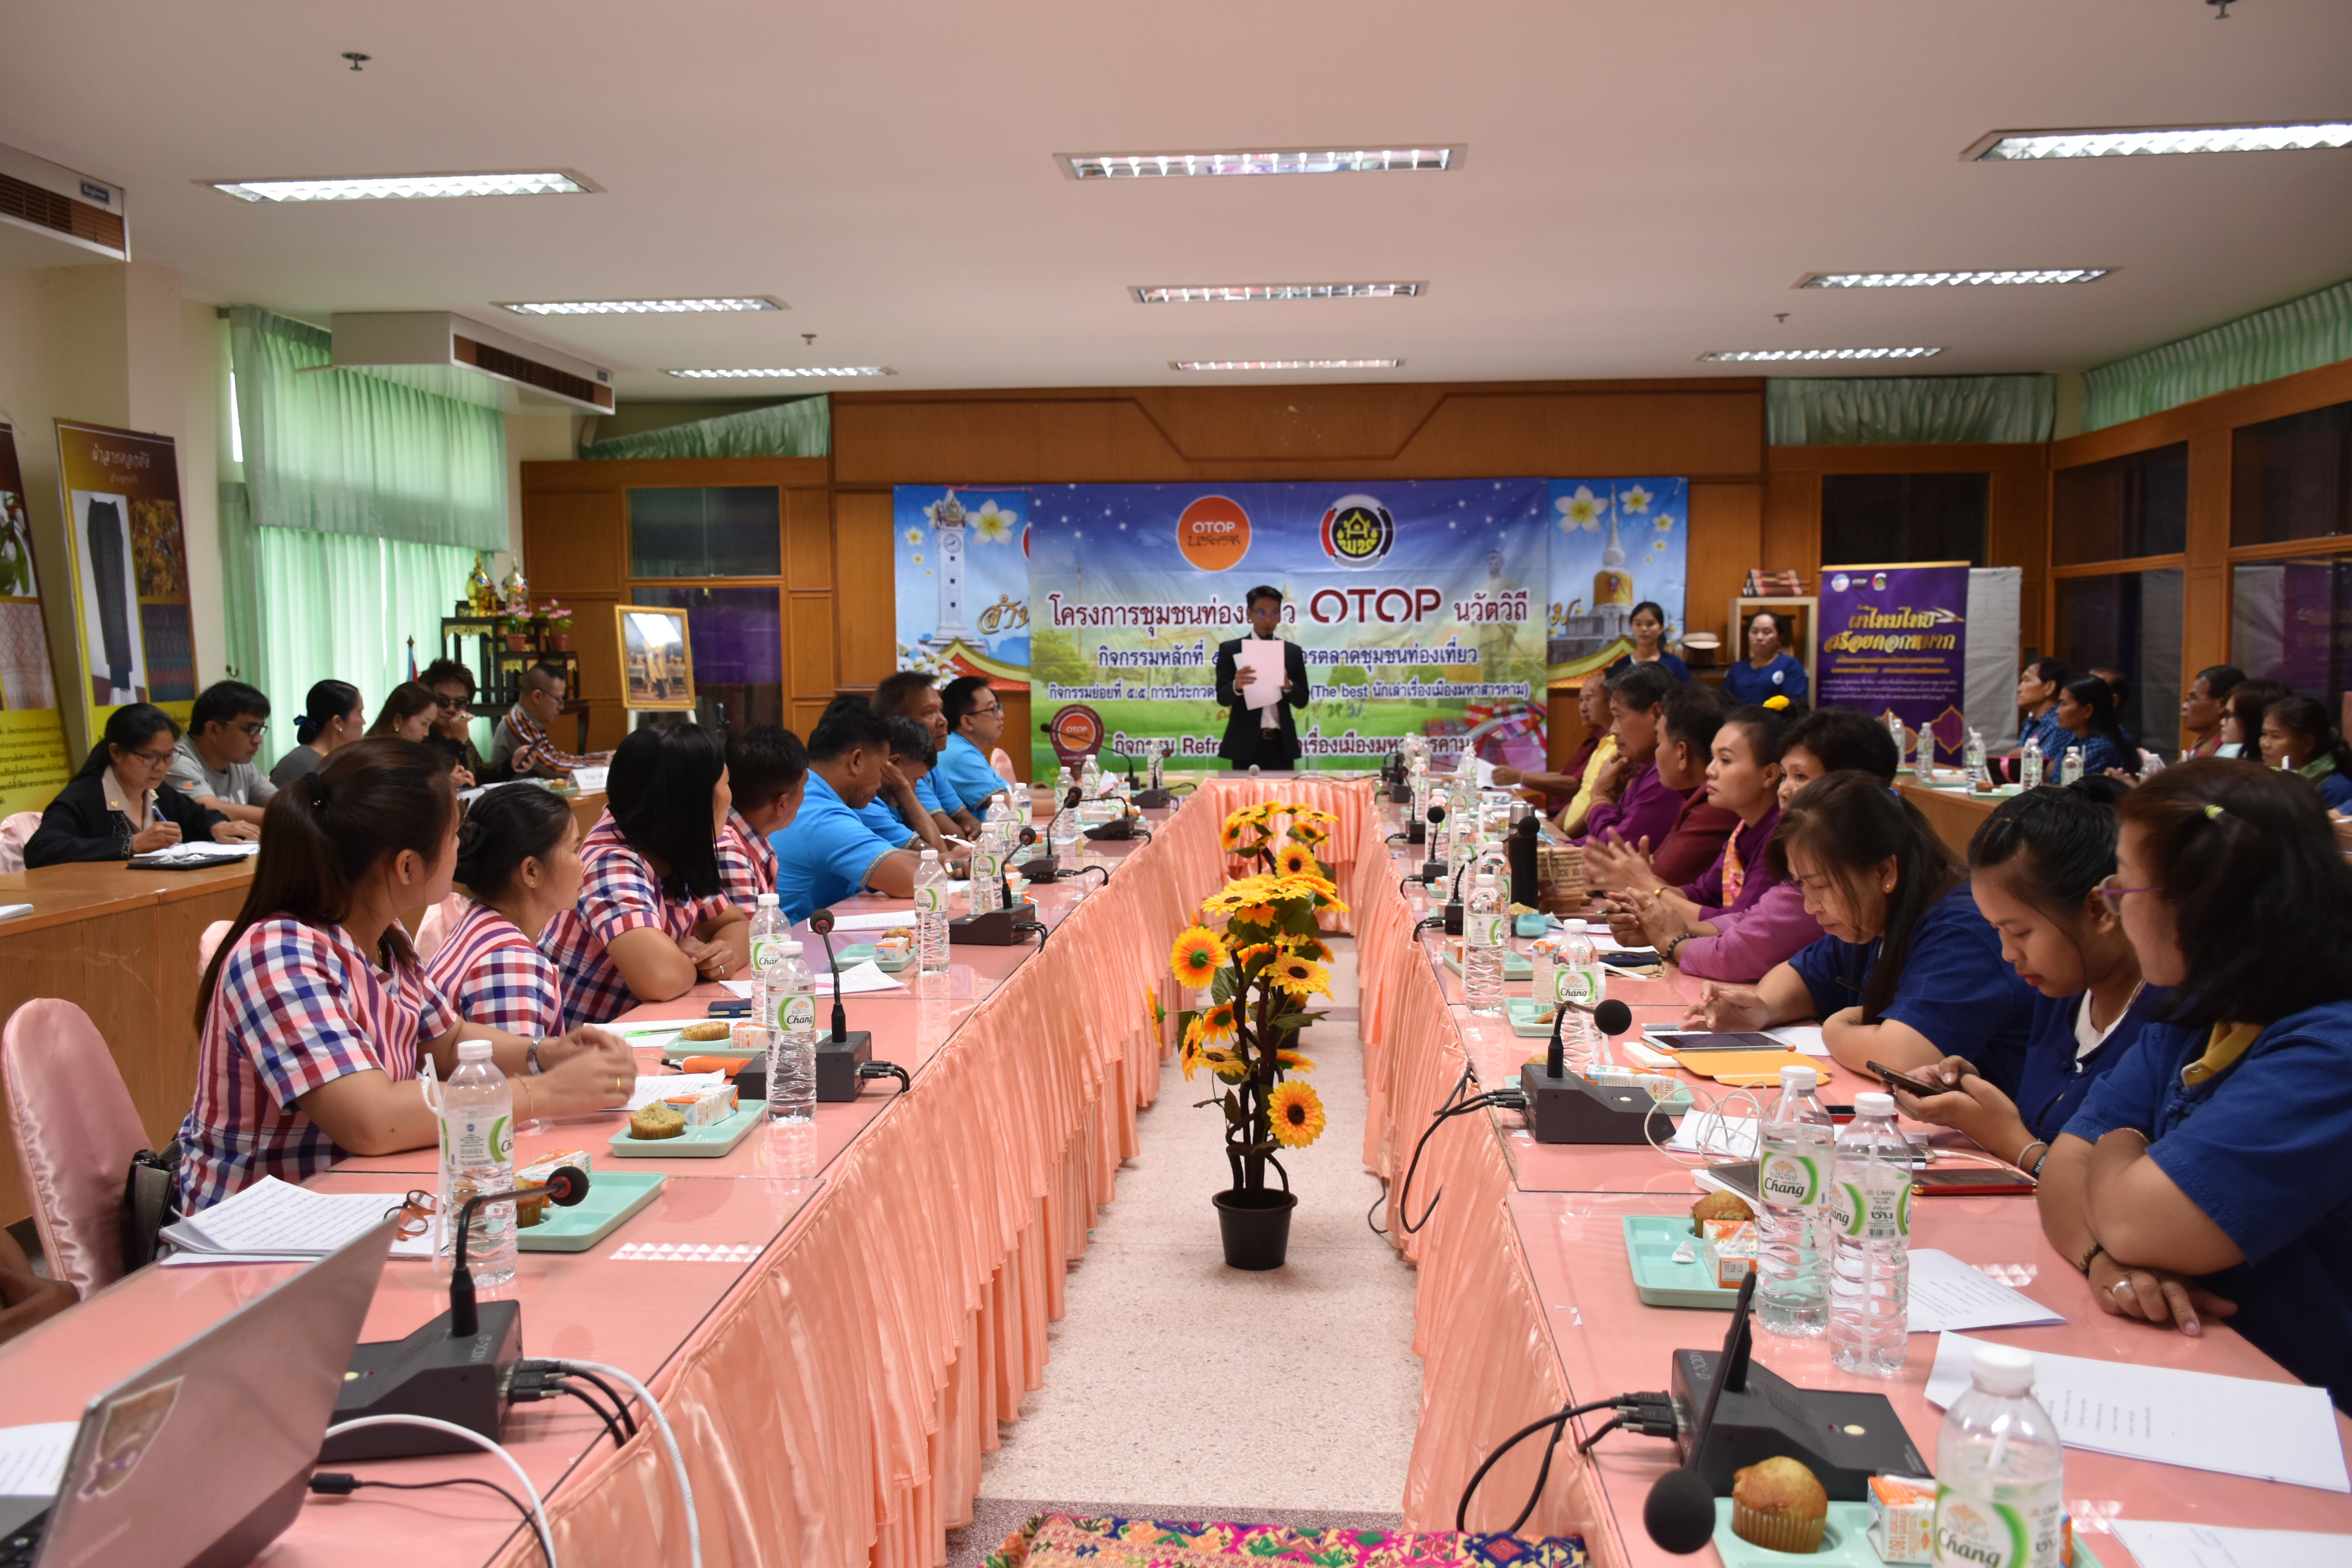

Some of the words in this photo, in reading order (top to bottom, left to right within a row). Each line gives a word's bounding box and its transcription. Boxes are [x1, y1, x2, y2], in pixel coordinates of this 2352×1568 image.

[1192, 521, 1236, 534] OTOP
[1310, 589, 1441, 622] OTOP
[1454, 590, 1527, 621] นวัตวิถี
[1099, 639, 1203, 666] กิจกรรมหลักที่
[1050, 680, 1122, 699] กิจกรรมย่อยที่
[1310, 684, 1336, 699] (The
[1342, 684, 1368, 698] best
[915, 900, 931, 909] Chang
[1560, 987, 1587, 998] Chang
[786, 1015, 813, 1025] Chang
[1665, 1083, 1674, 1093] 180
[1764, 1177, 1805, 1198] Chang
[1889, 1535, 1906, 1550] 180
